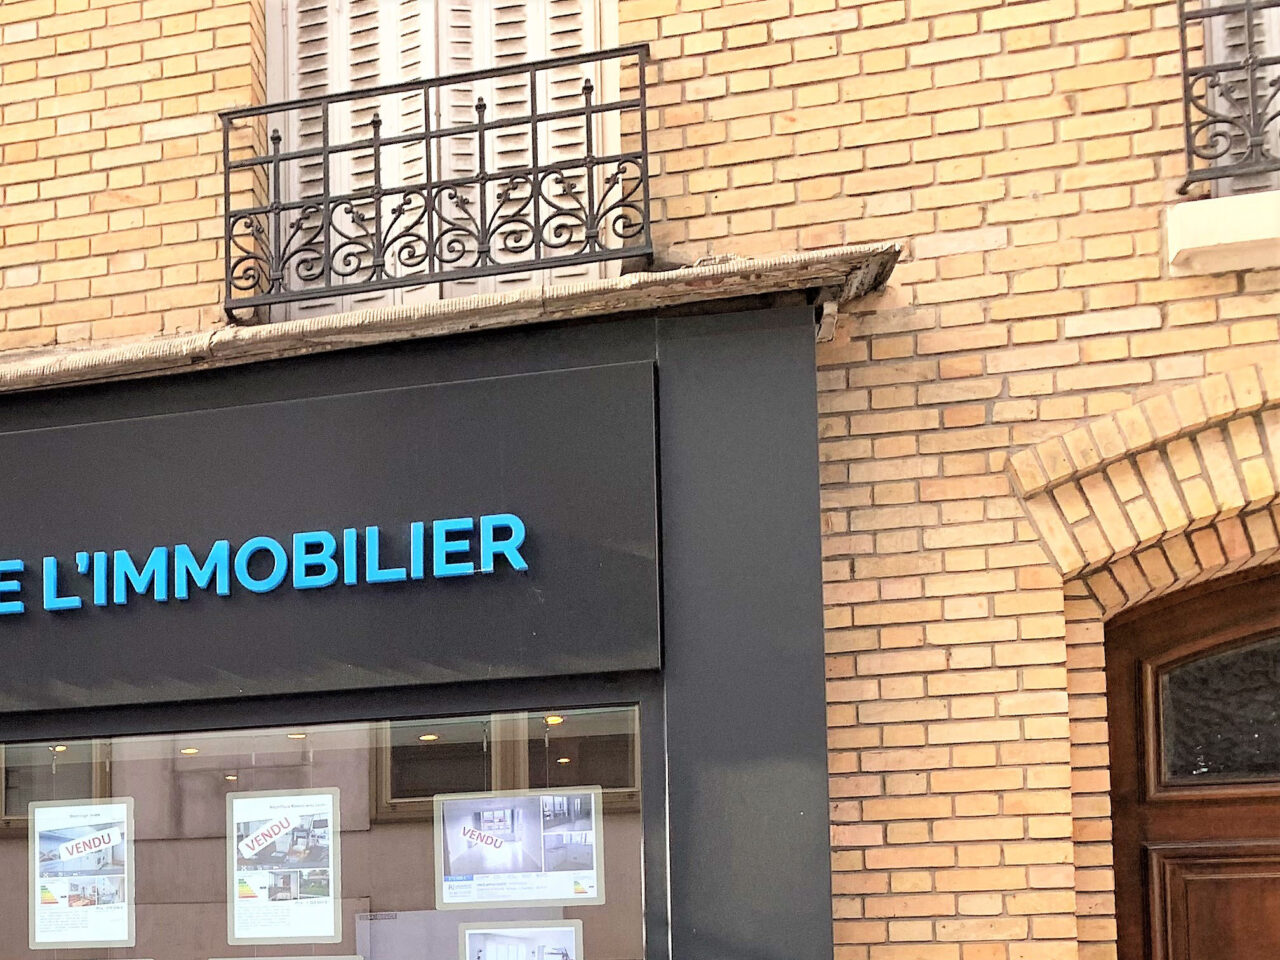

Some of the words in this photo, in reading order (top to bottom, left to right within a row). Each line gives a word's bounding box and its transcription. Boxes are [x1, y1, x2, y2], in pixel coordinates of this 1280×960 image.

[43, 512, 529, 611] L'IMMOBILIER
[65, 832, 113, 857] VENDU
[244, 816, 291, 852] VENDU
[462, 826, 504, 849] VENDU
